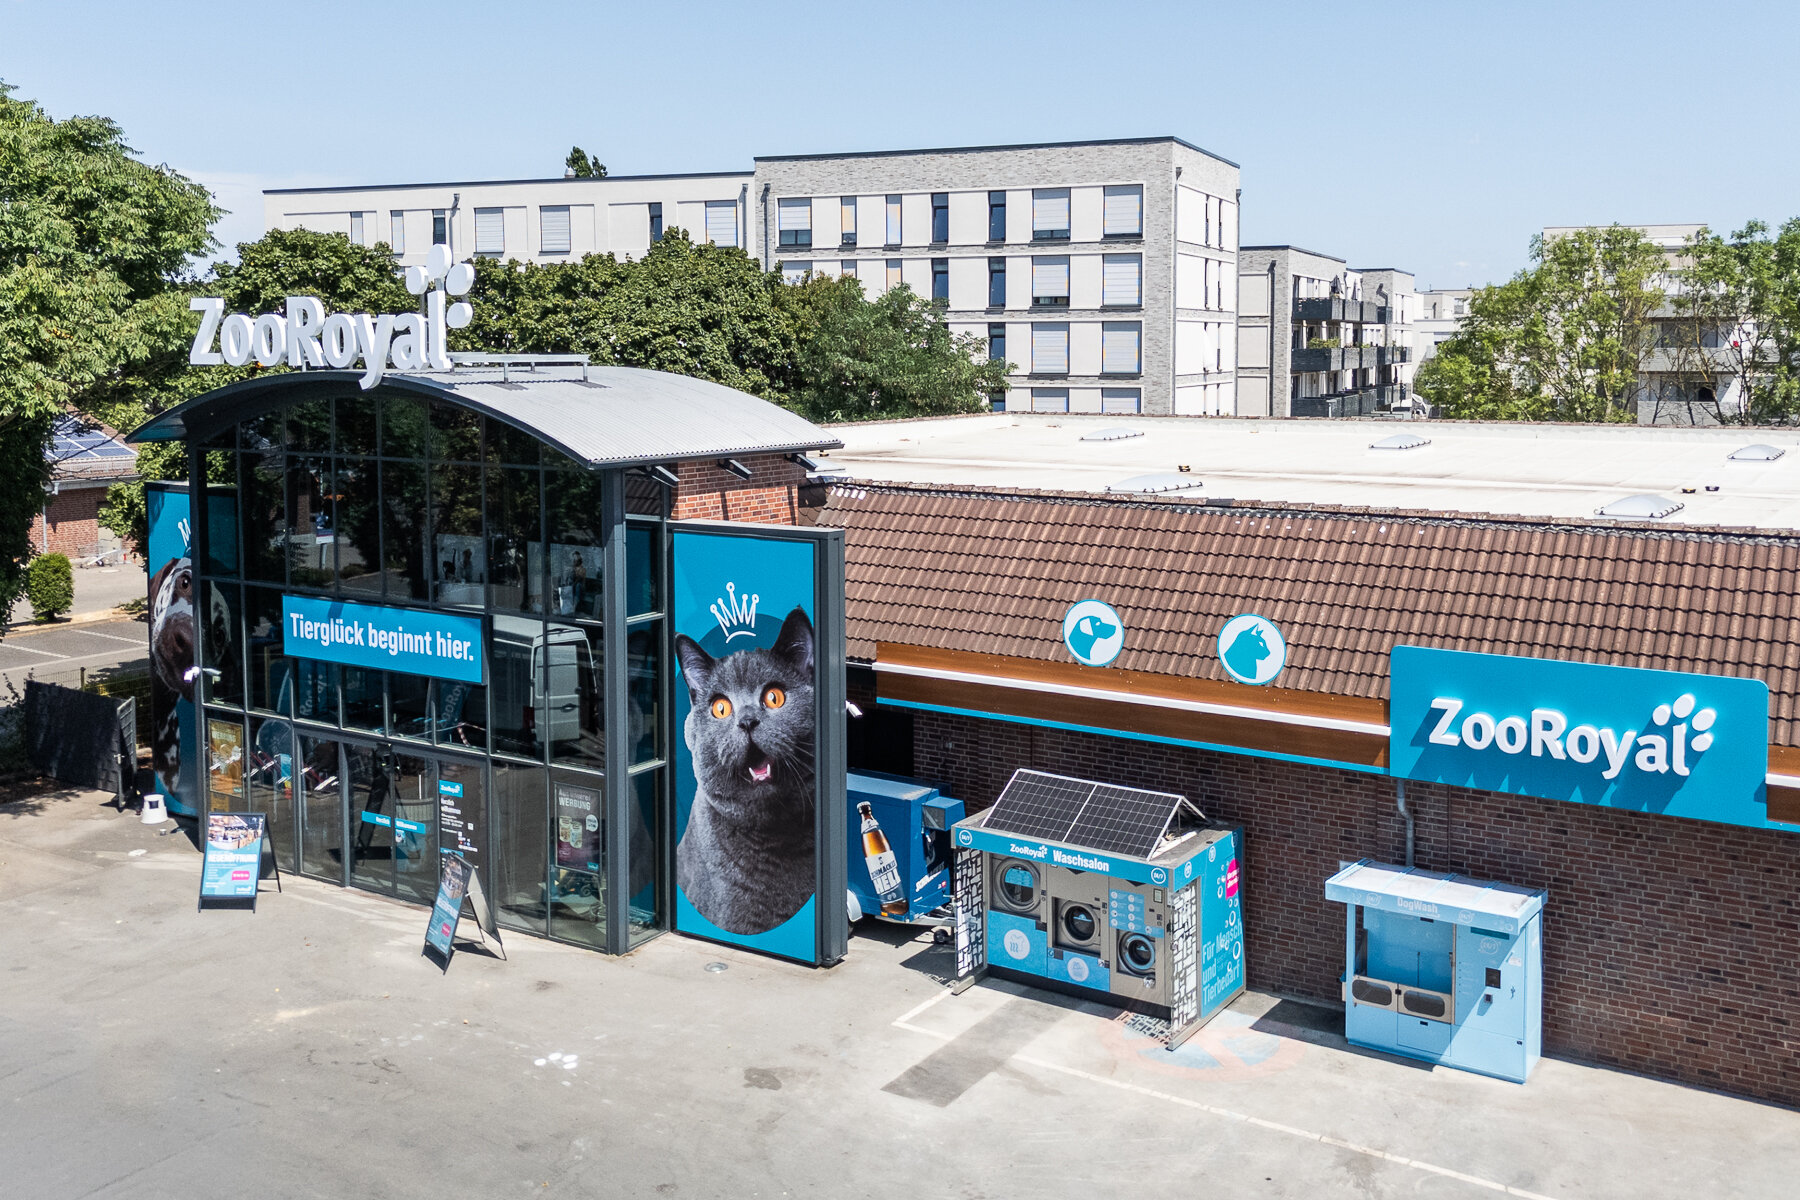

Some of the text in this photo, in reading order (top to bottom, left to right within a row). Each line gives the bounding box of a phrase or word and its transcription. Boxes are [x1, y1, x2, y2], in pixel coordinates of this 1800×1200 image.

[189, 288, 453, 391] ZooRoyal
[290, 613, 474, 661] Tierglück beginnt hier.
[1428, 697, 1690, 780] ZooRoyal
[1010, 843, 1110, 872] ZooRoyal Waschsalon
[1397, 896, 1438, 913] DogWash
[1202, 941, 1215, 964] Für
[1202, 958, 1216, 985] und
[1203, 959, 1240, 1005] Tierbedarf
